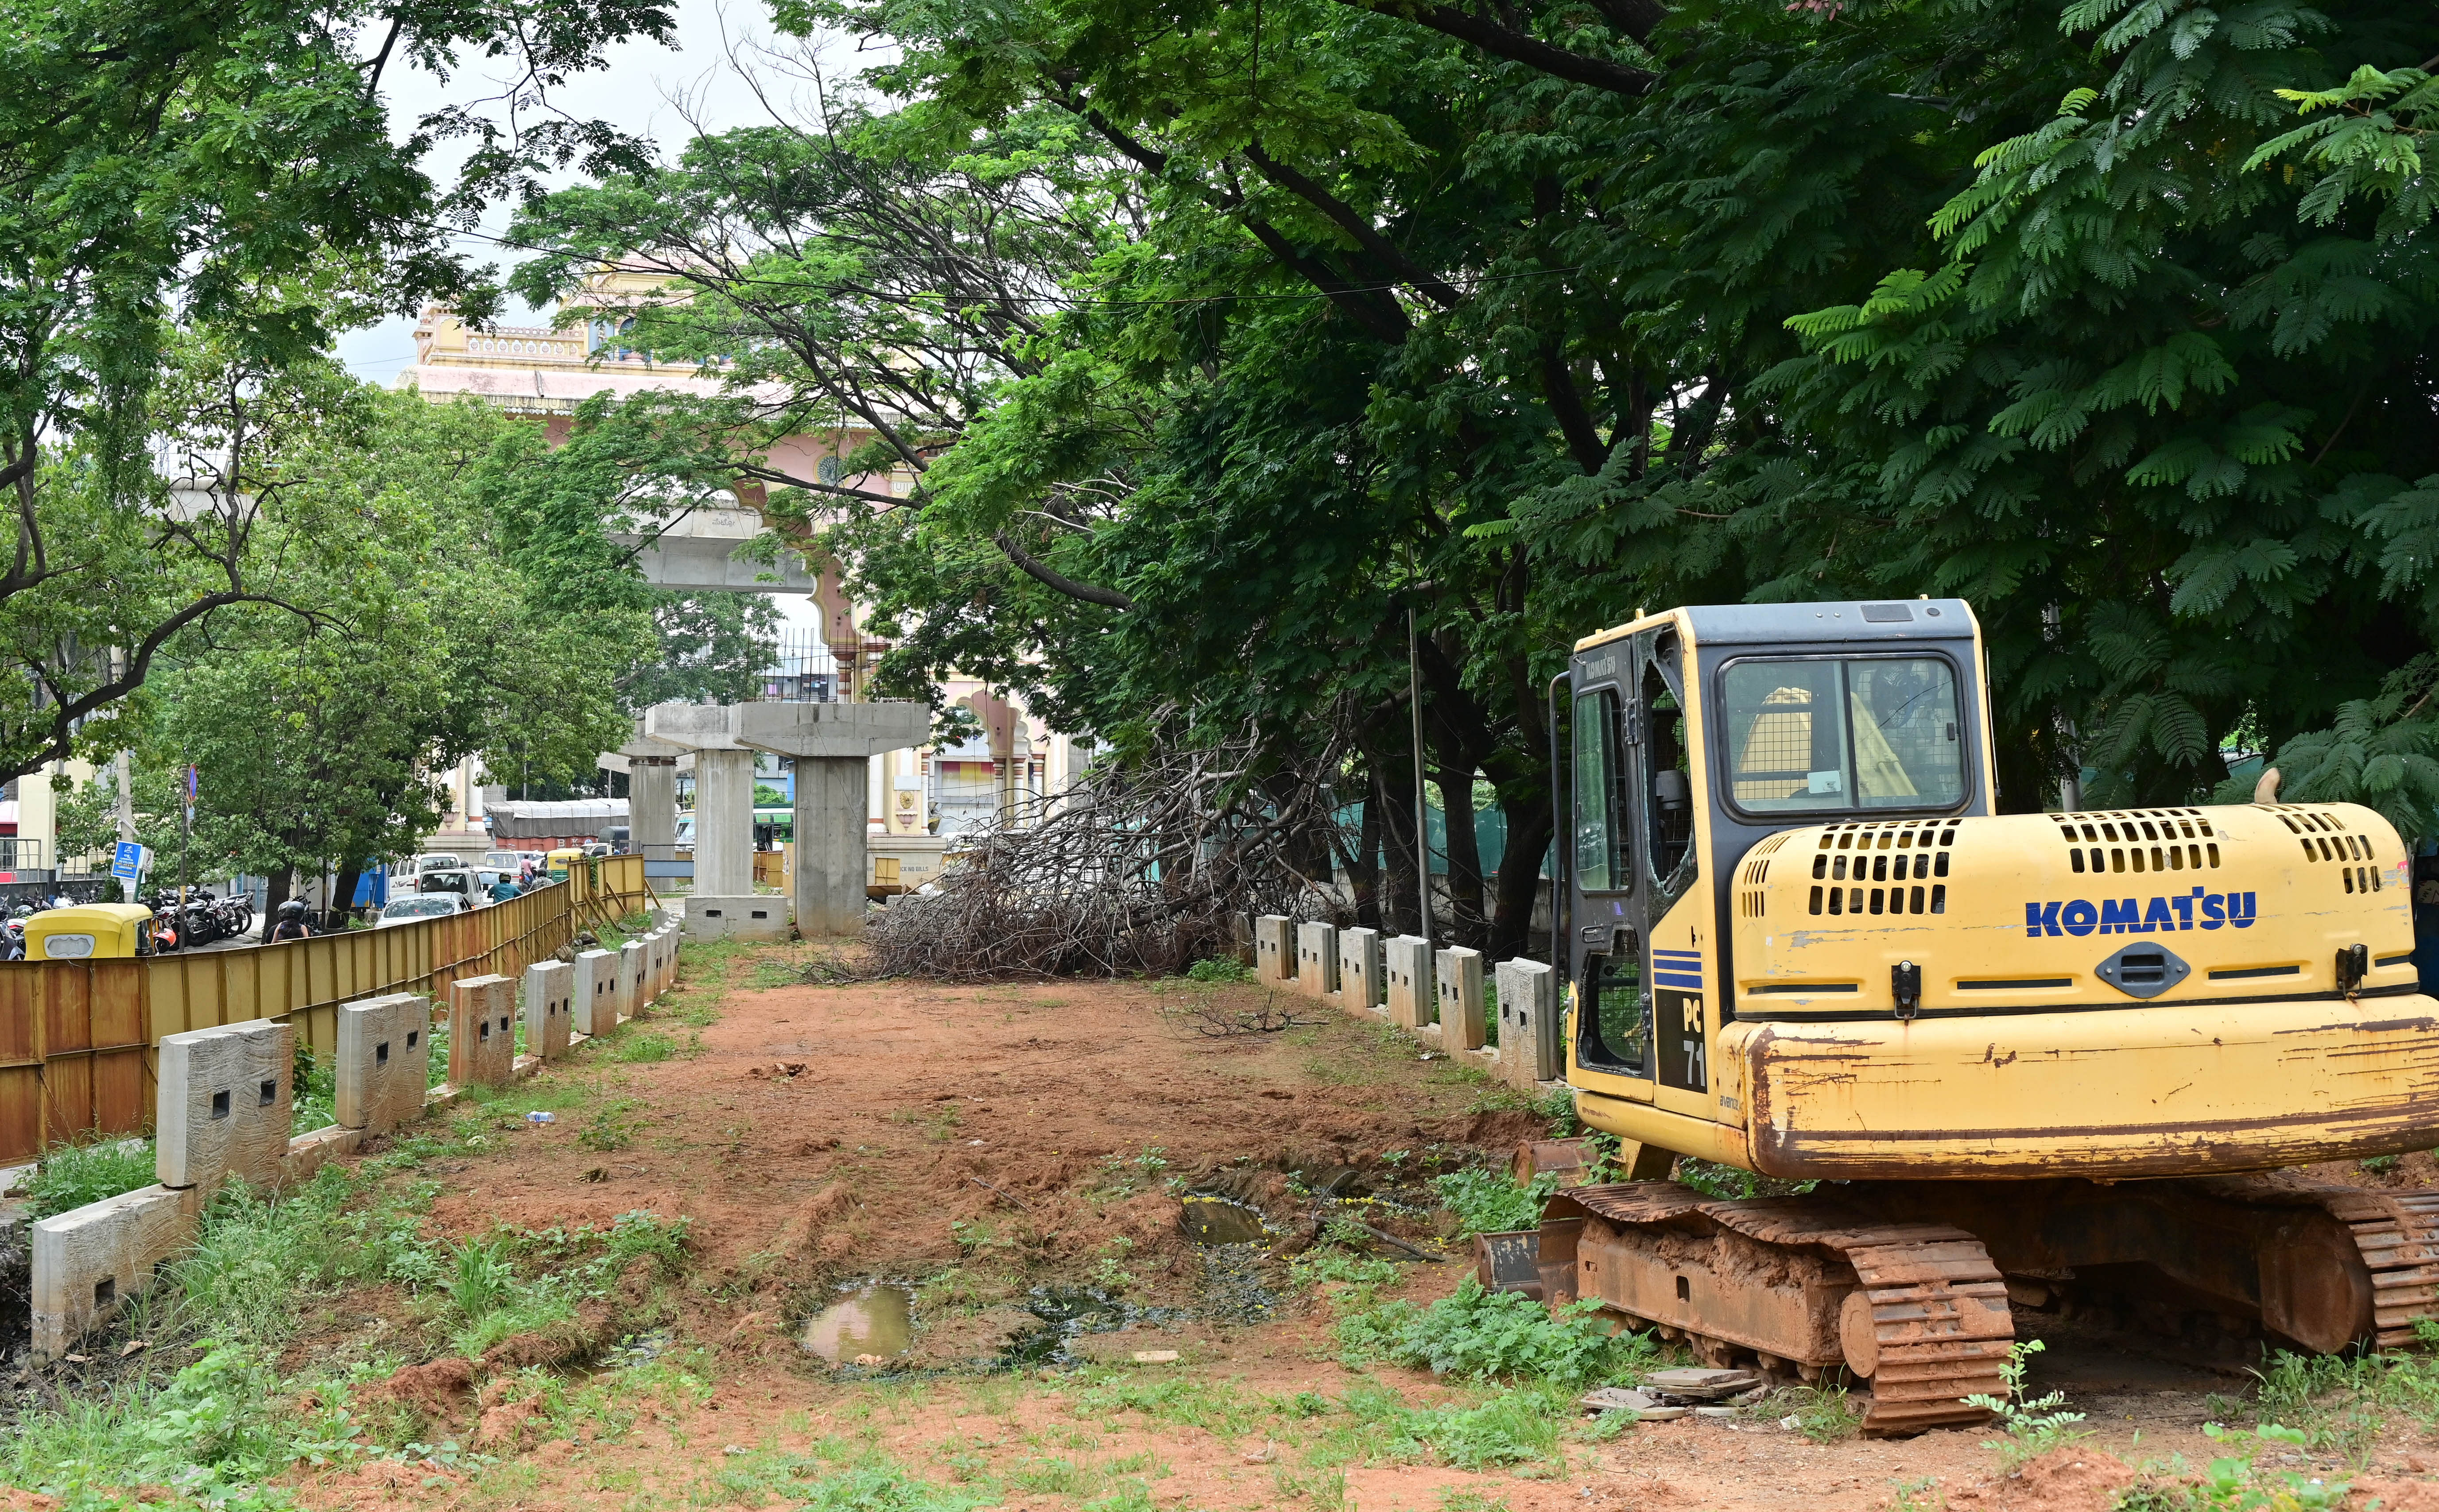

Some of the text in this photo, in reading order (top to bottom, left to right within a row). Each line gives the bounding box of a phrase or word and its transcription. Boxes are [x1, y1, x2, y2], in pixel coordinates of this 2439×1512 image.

[1586, 653, 1616, 680] KOMATSU
[2025, 886, 2256, 937] KOMATSU
[1683, 998, 1701, 1033] PC
[1683, 1040, 1705, 1087] 71
